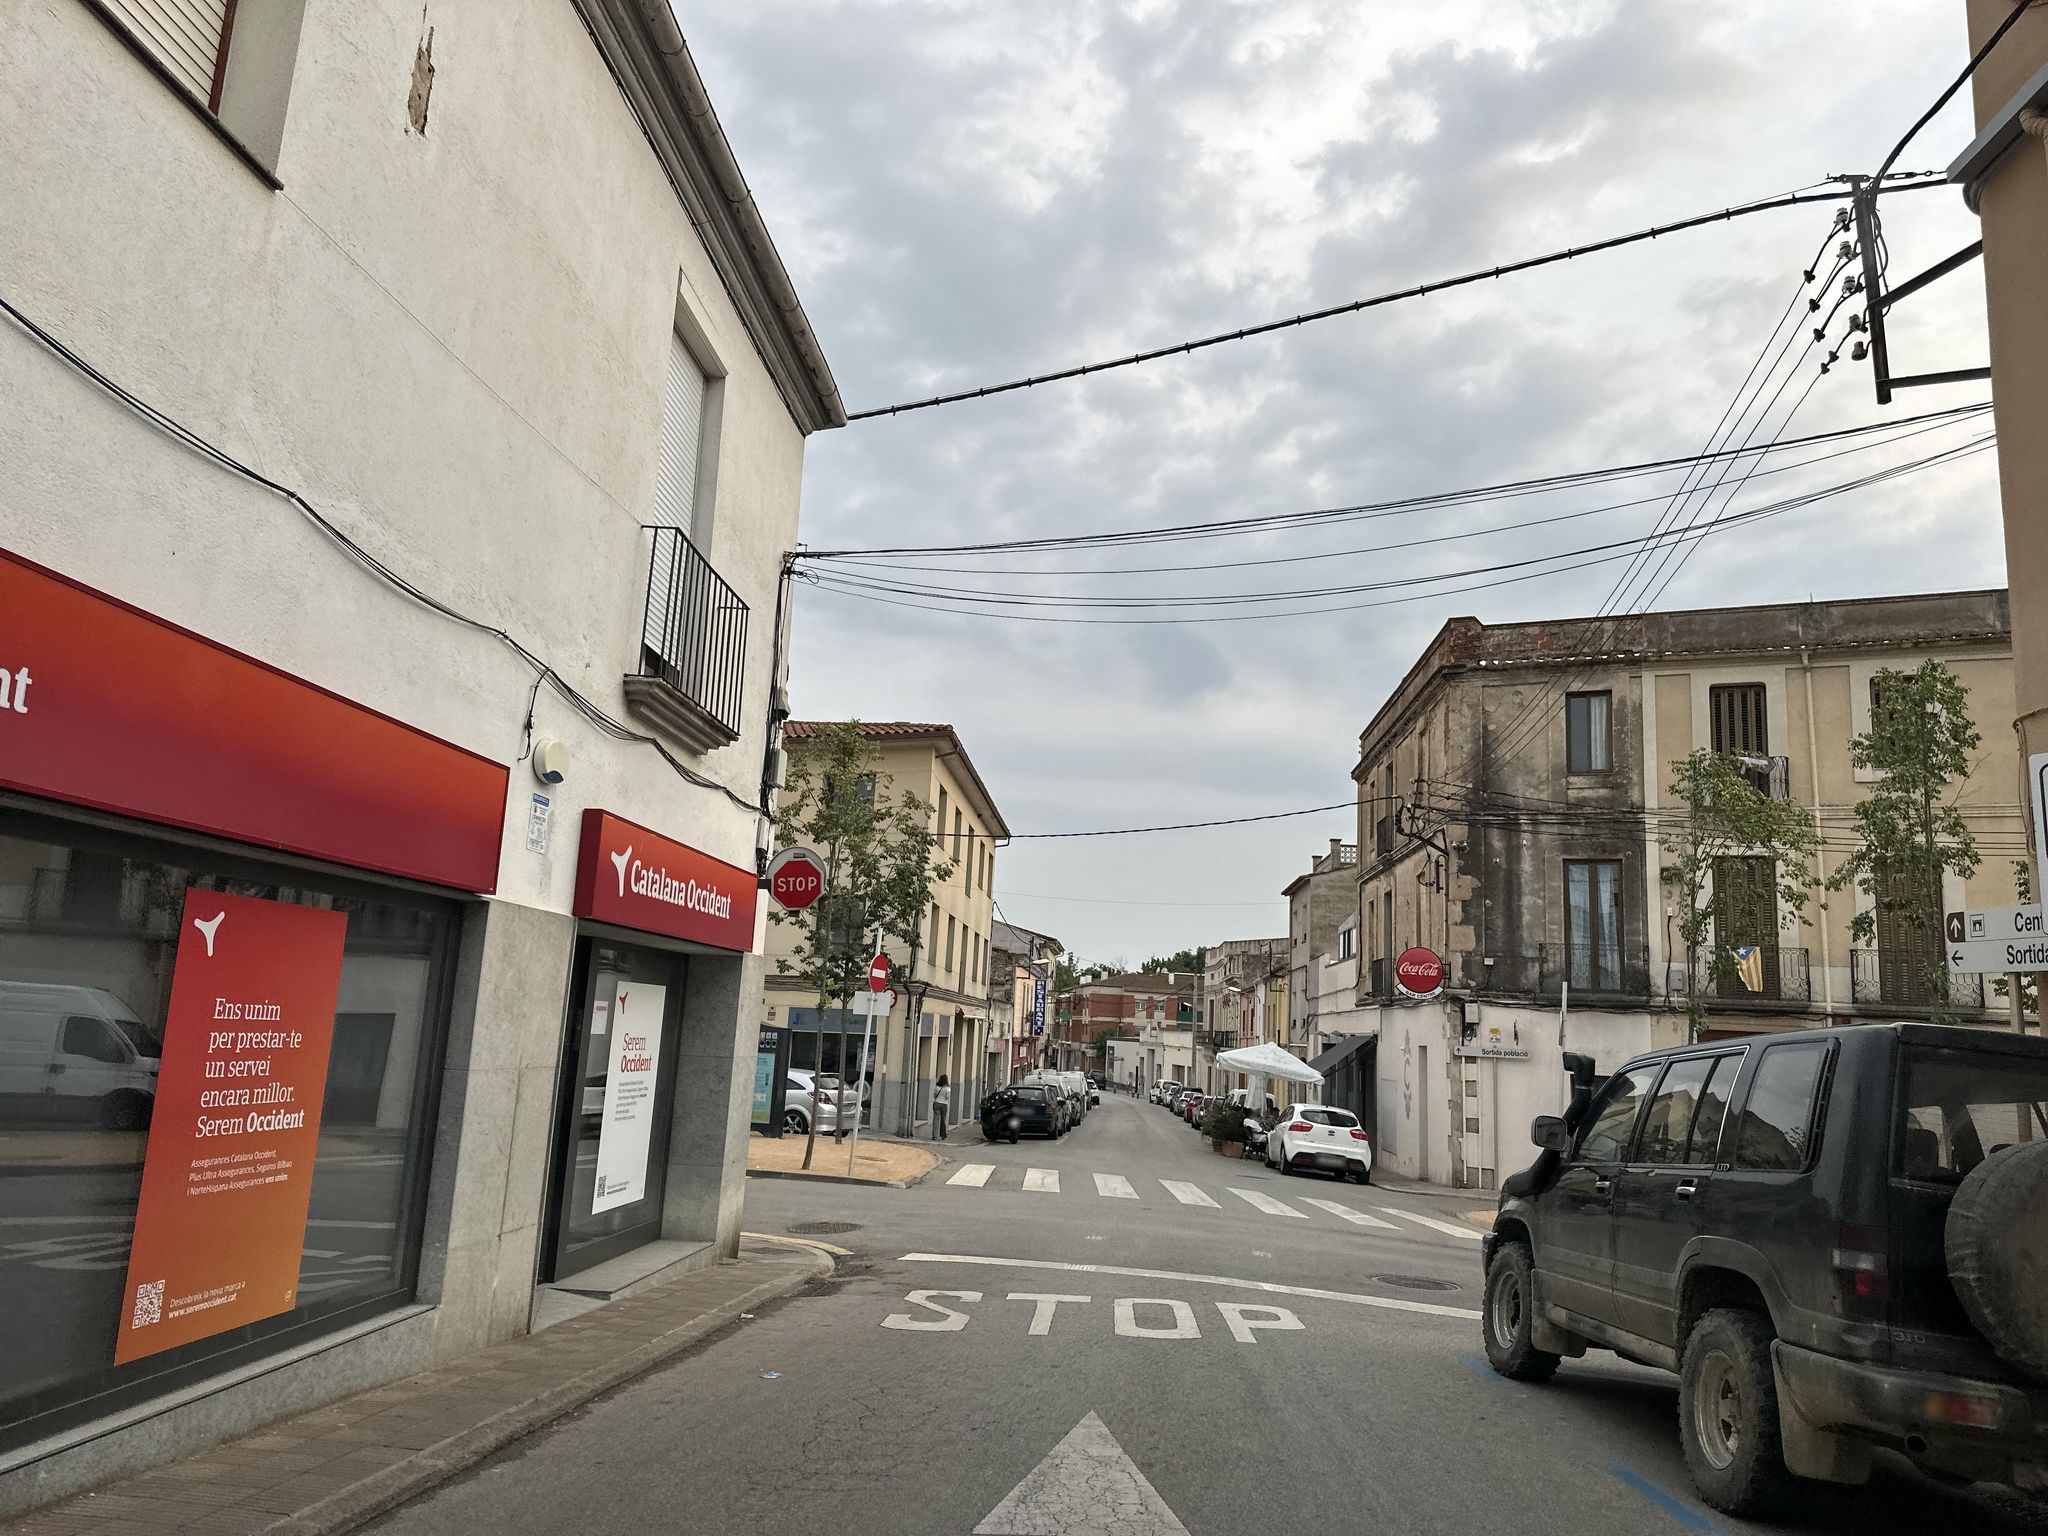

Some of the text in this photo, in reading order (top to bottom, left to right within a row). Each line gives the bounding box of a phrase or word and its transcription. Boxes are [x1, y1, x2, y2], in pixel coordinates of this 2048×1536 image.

[630, 859, 732, 920] Catalana Occident
[777, 876, 818, 893] STOP
[1399, 962, 1440, 977] Coca-Cola
[213, 998, 281, 1021] Ens unim
[208, 1029, 302, 1053] per prestar-te
[622, 1032, 647, 1051] Serem
[620, 1053, 652, 1073] Occident
[1481, 1048, 1529, 1058] Sortida població
[205, 1055, 271, 1078] un servei
[200, 1082, 295, 1108] encara millor.
[195, 1109, 305, 1138] Serem Occident
[191, 1156, 230, 1168] Assegurances
[231, 1152, 254, 1163] Catalana
[188, 1173, 202, 1182] Plus
[203, 1170, 217, 1180] Ultra
[256, 1162, 277, 1173] Seguros
[190, 1183, 229, 1196] NorteHispana
[229, 1177, 265, 1190] Assegurances
[168, 1292, 238, 1319] www.seremoccident.cat
[169, 1293, 202, 1308] Descobreix
[209, 1286, 224, 1297] nova
[224, 1282, 241, 1293] marca
[879, 1289, 1306, 1344] STOP
